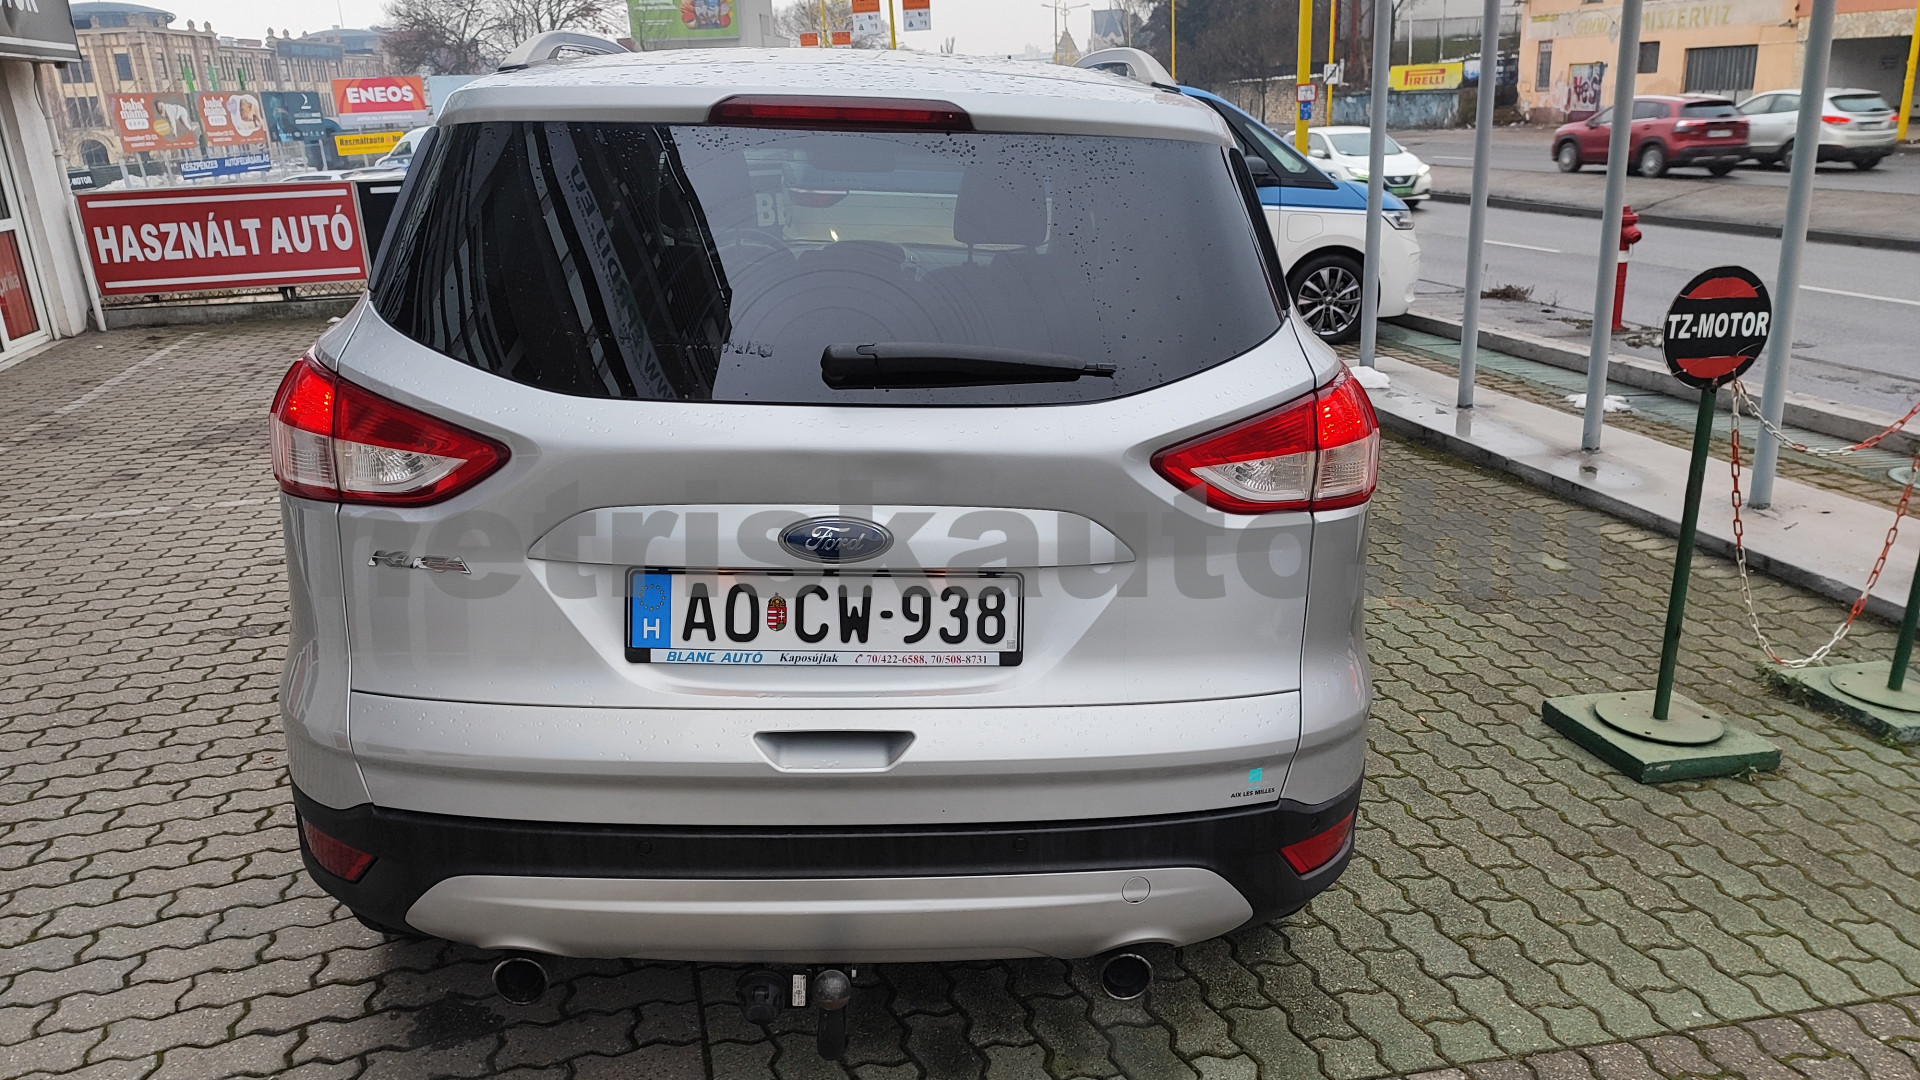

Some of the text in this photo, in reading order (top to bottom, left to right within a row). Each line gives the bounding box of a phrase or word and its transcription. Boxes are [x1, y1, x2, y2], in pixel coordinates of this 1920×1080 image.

[1616, 4, 1731, 32] MISZERVIZ
[1403, 68, 1446, 86] PIRELLI
[345, 84, 415, 104] ENEOS
[93, 204, 354, 264] HASZNÁLT AUTÓ
[1668, 311, 1770, 339] TZ-MOTOR
[805, 525, 866, 552] Ford
[682, 582, 1006, 644] AO CW-938
[643, 617, 661, 639] H
[666, 651, 988, 665] BLANC AUTÓ Kaposújlak 70/422-6588, 70/508-8731
[1254, 787, 1276, 796] MILLES
